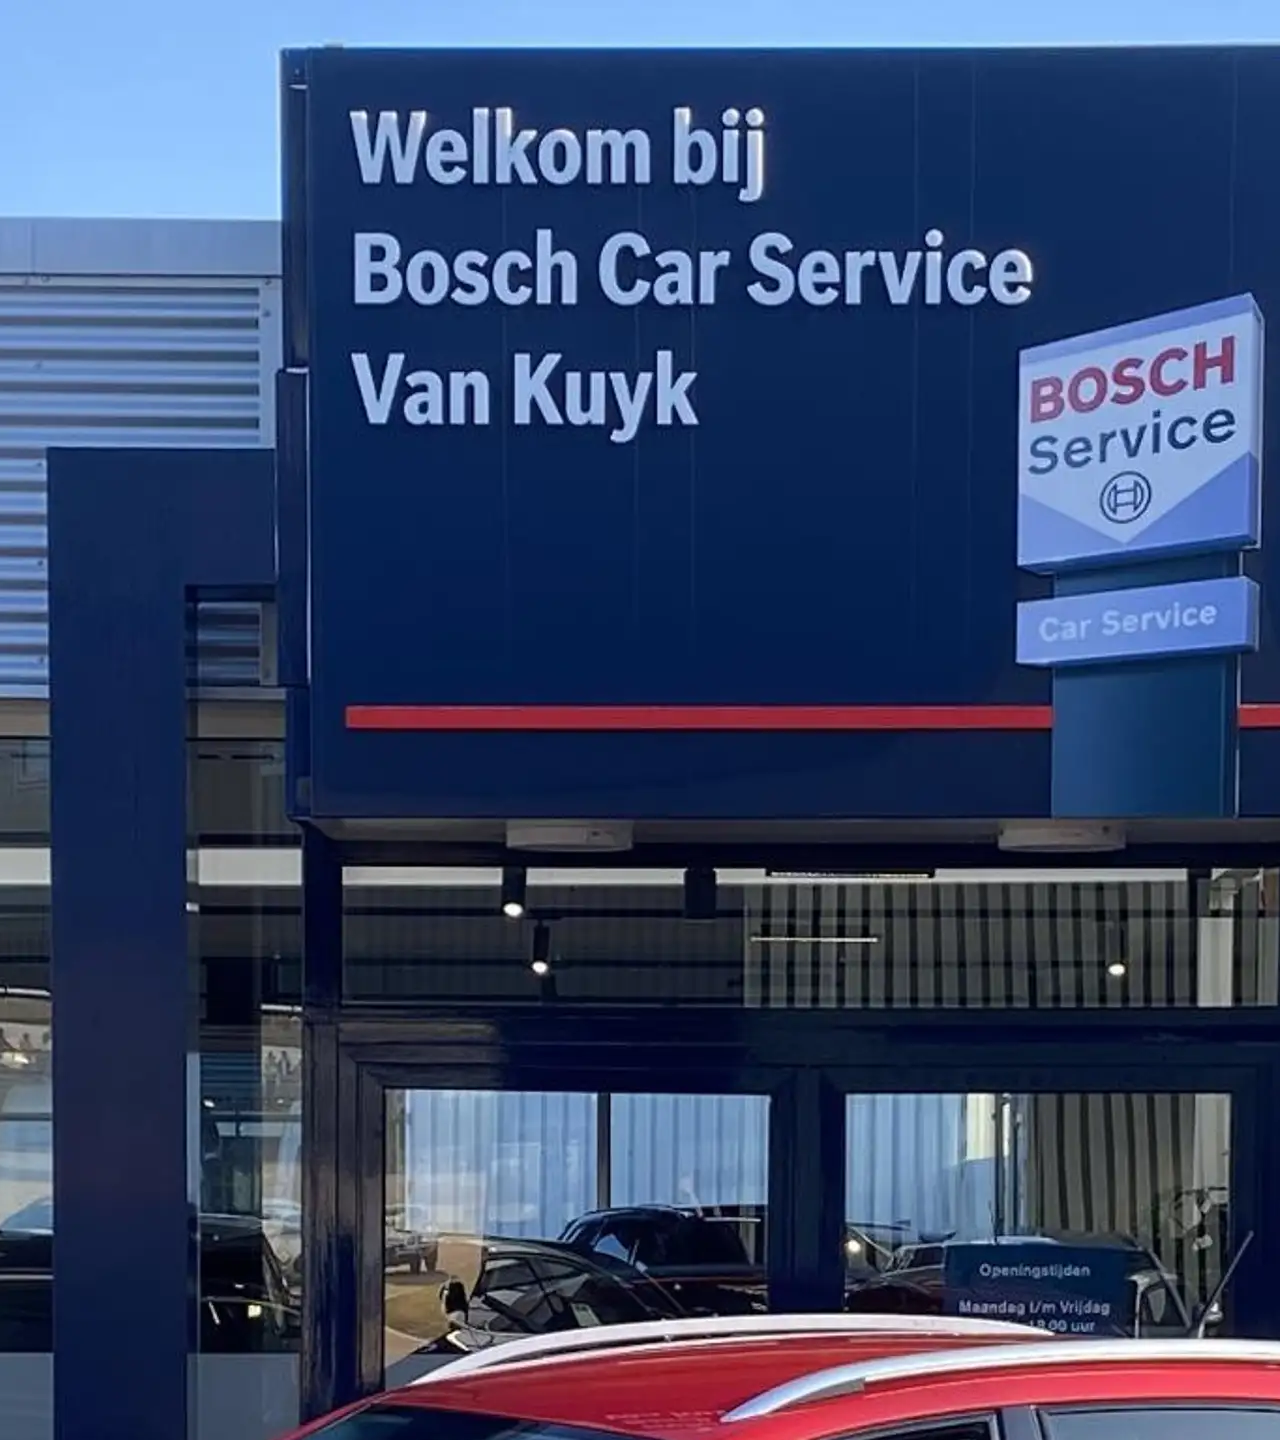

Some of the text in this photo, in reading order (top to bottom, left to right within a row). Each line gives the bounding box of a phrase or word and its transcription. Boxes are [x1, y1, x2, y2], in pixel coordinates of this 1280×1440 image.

[348, 105, 767, 203] Welkom bij
[353, 227, 1034, 307] Bosch Car Service
[350, 349, 700, 444] Van Kuyk
[1030, 335, 1236, 424] BOSCH
[1028, 408, 1236, 475] Service
[1038, 602, 1218, 642] Car Service
[978, 1262, 1092, 1279] Openingstijden
[958, 1300, 1026, 1316] Maandag
[1059, 1300, 1111, 1316] Vrijdag
